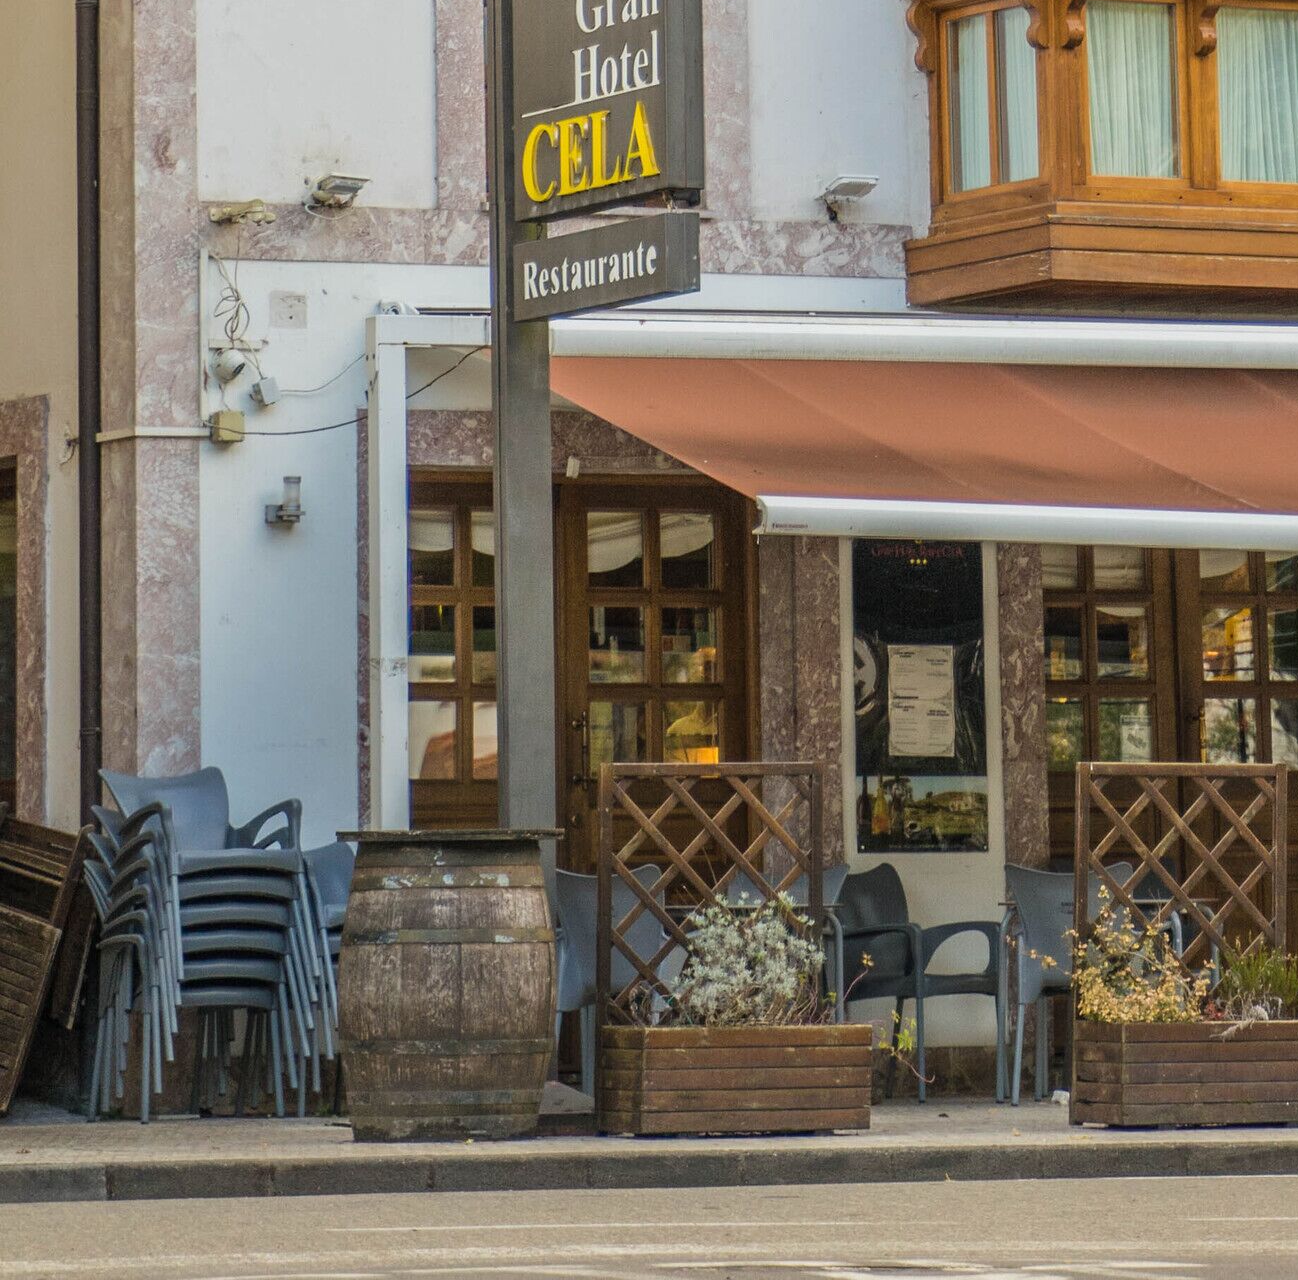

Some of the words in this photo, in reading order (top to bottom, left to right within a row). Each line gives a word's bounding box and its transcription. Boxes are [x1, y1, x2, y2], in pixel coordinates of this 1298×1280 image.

[572, 29, 660, 104] Hotel
[522, 101, 661, 203] CELA
[523, 240, 658, 300] Restaurante
